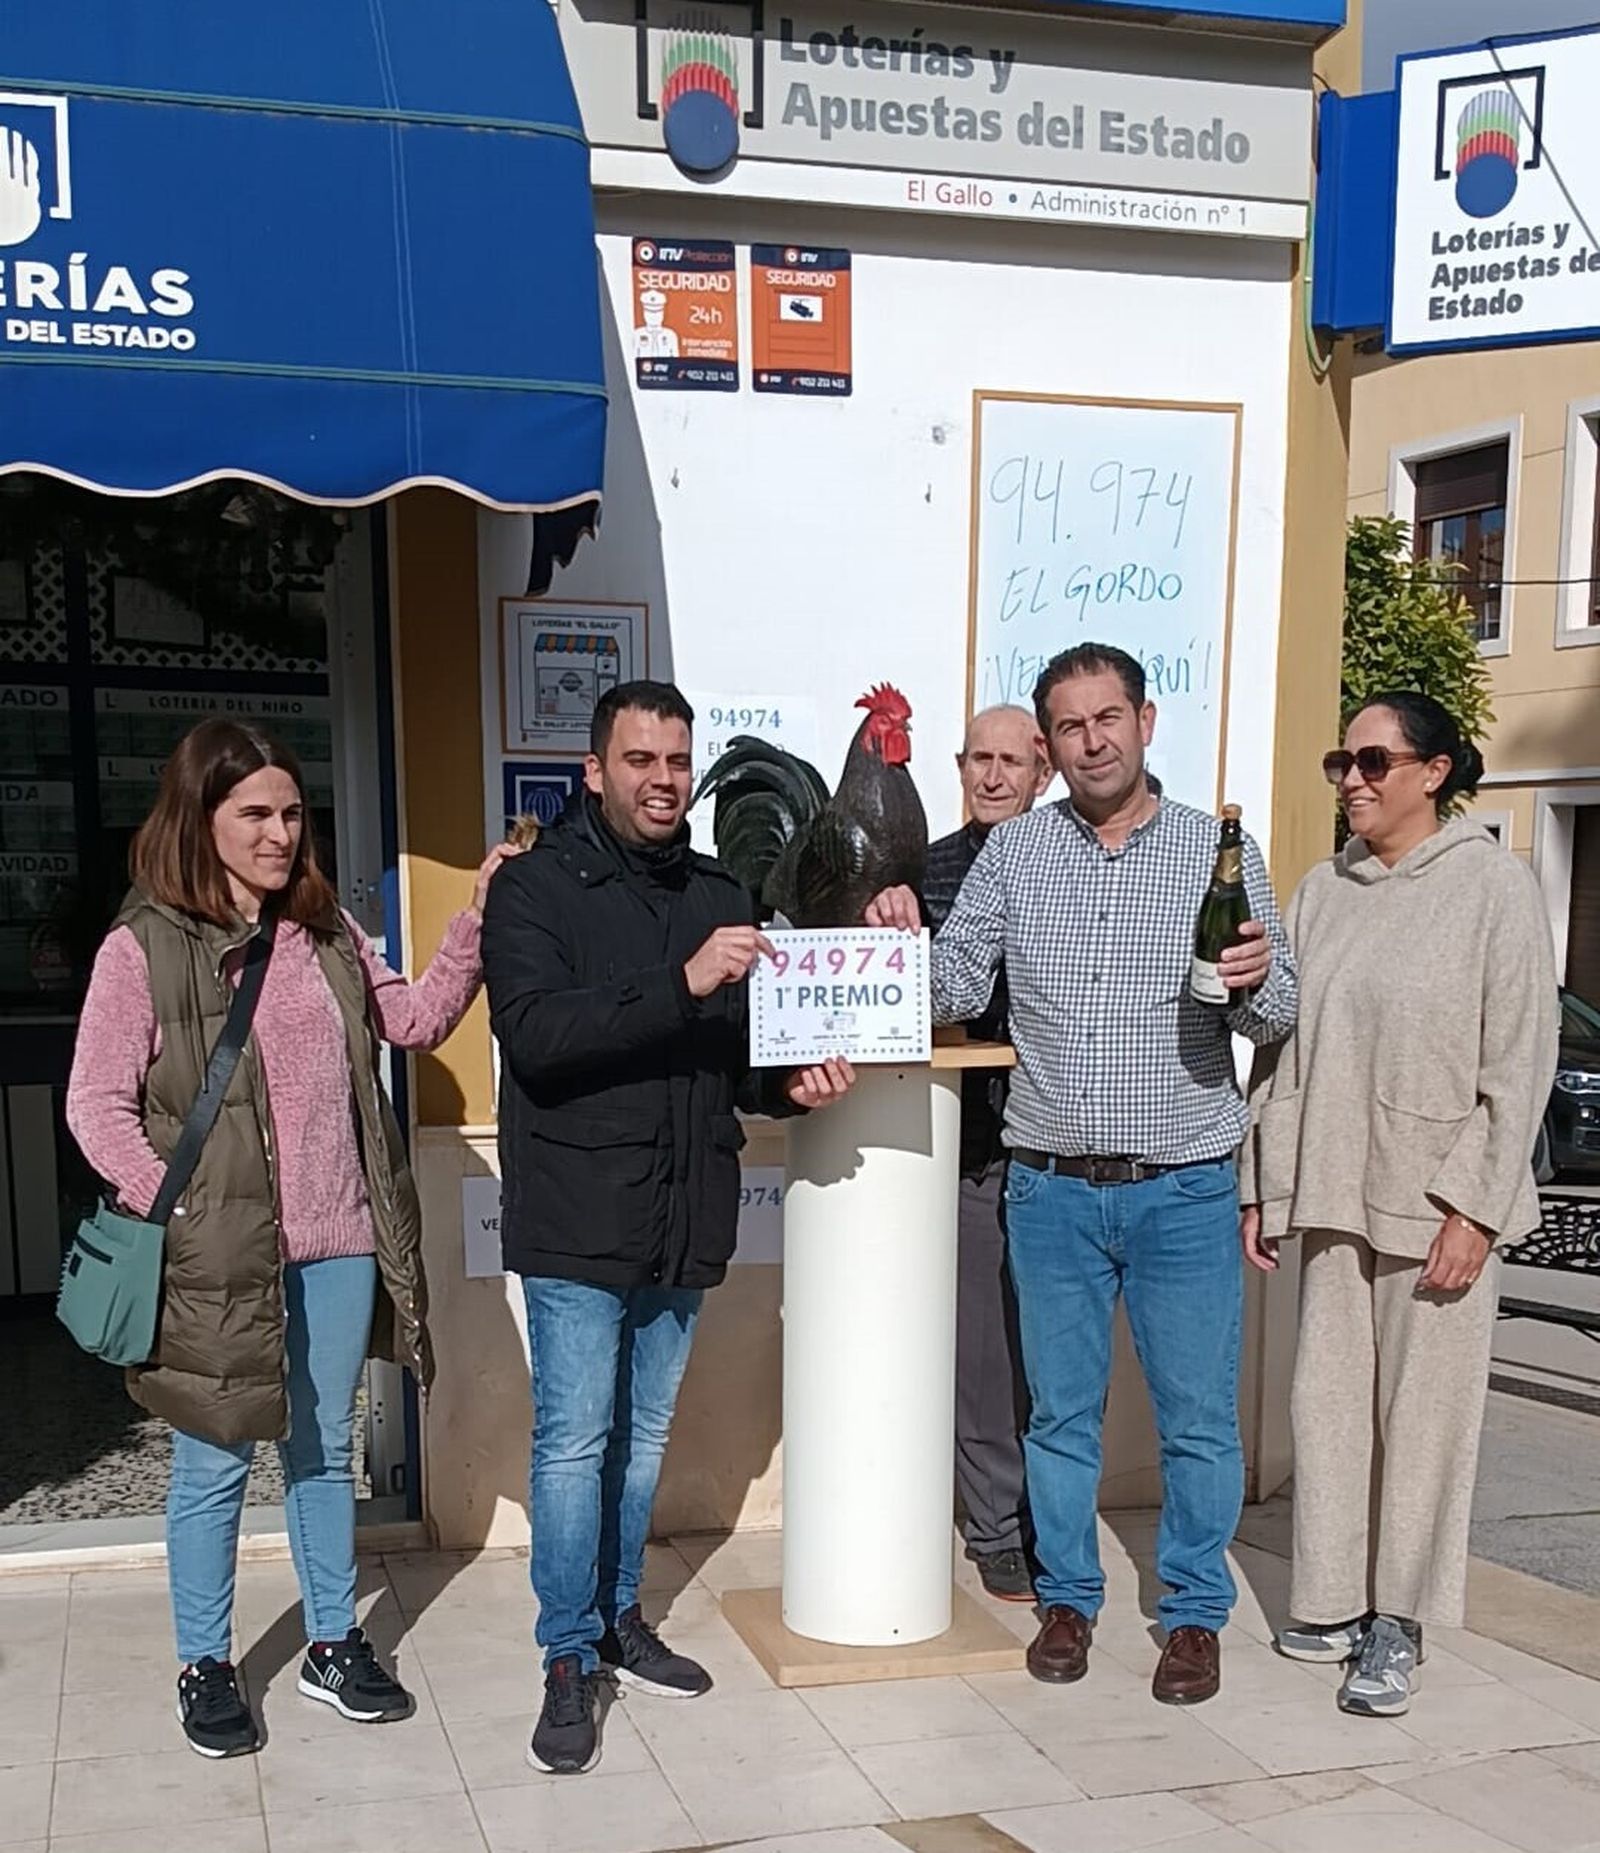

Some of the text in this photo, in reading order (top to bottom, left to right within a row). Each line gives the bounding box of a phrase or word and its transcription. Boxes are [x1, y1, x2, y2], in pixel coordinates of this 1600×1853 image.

[780, 18, 1016, 94] Loterías y
[781, 81, 1250, 164] Apuestas del Estado
[908, 180, 925, 202] El
[936, 182, 993, 207] Gallo
[1031, 190, 1197, 226] Administración
[1239, 207, 1247, 226] 1
[1431, 221, 1570, 256] Loterías y
[0, 252, 194, 317] RÍAS
[638, 271, 731, 293] SEGURIDAD
[766, 269, 836, 289] SEGURIDAD
[1430, 255, 1560, 293] Apuestas
[689, 305, 722, 325] 24h
[1428, 288, 1524, 321] Estado
[6, 319, 196, 351] DEL ESTADO
[1000, 563, 1183, 623] EL GORDO
[709, 706, 783, 729] 94974
[772, 946, 906, 978] 94974
[798, 984, 903, 1009] PREMIO
